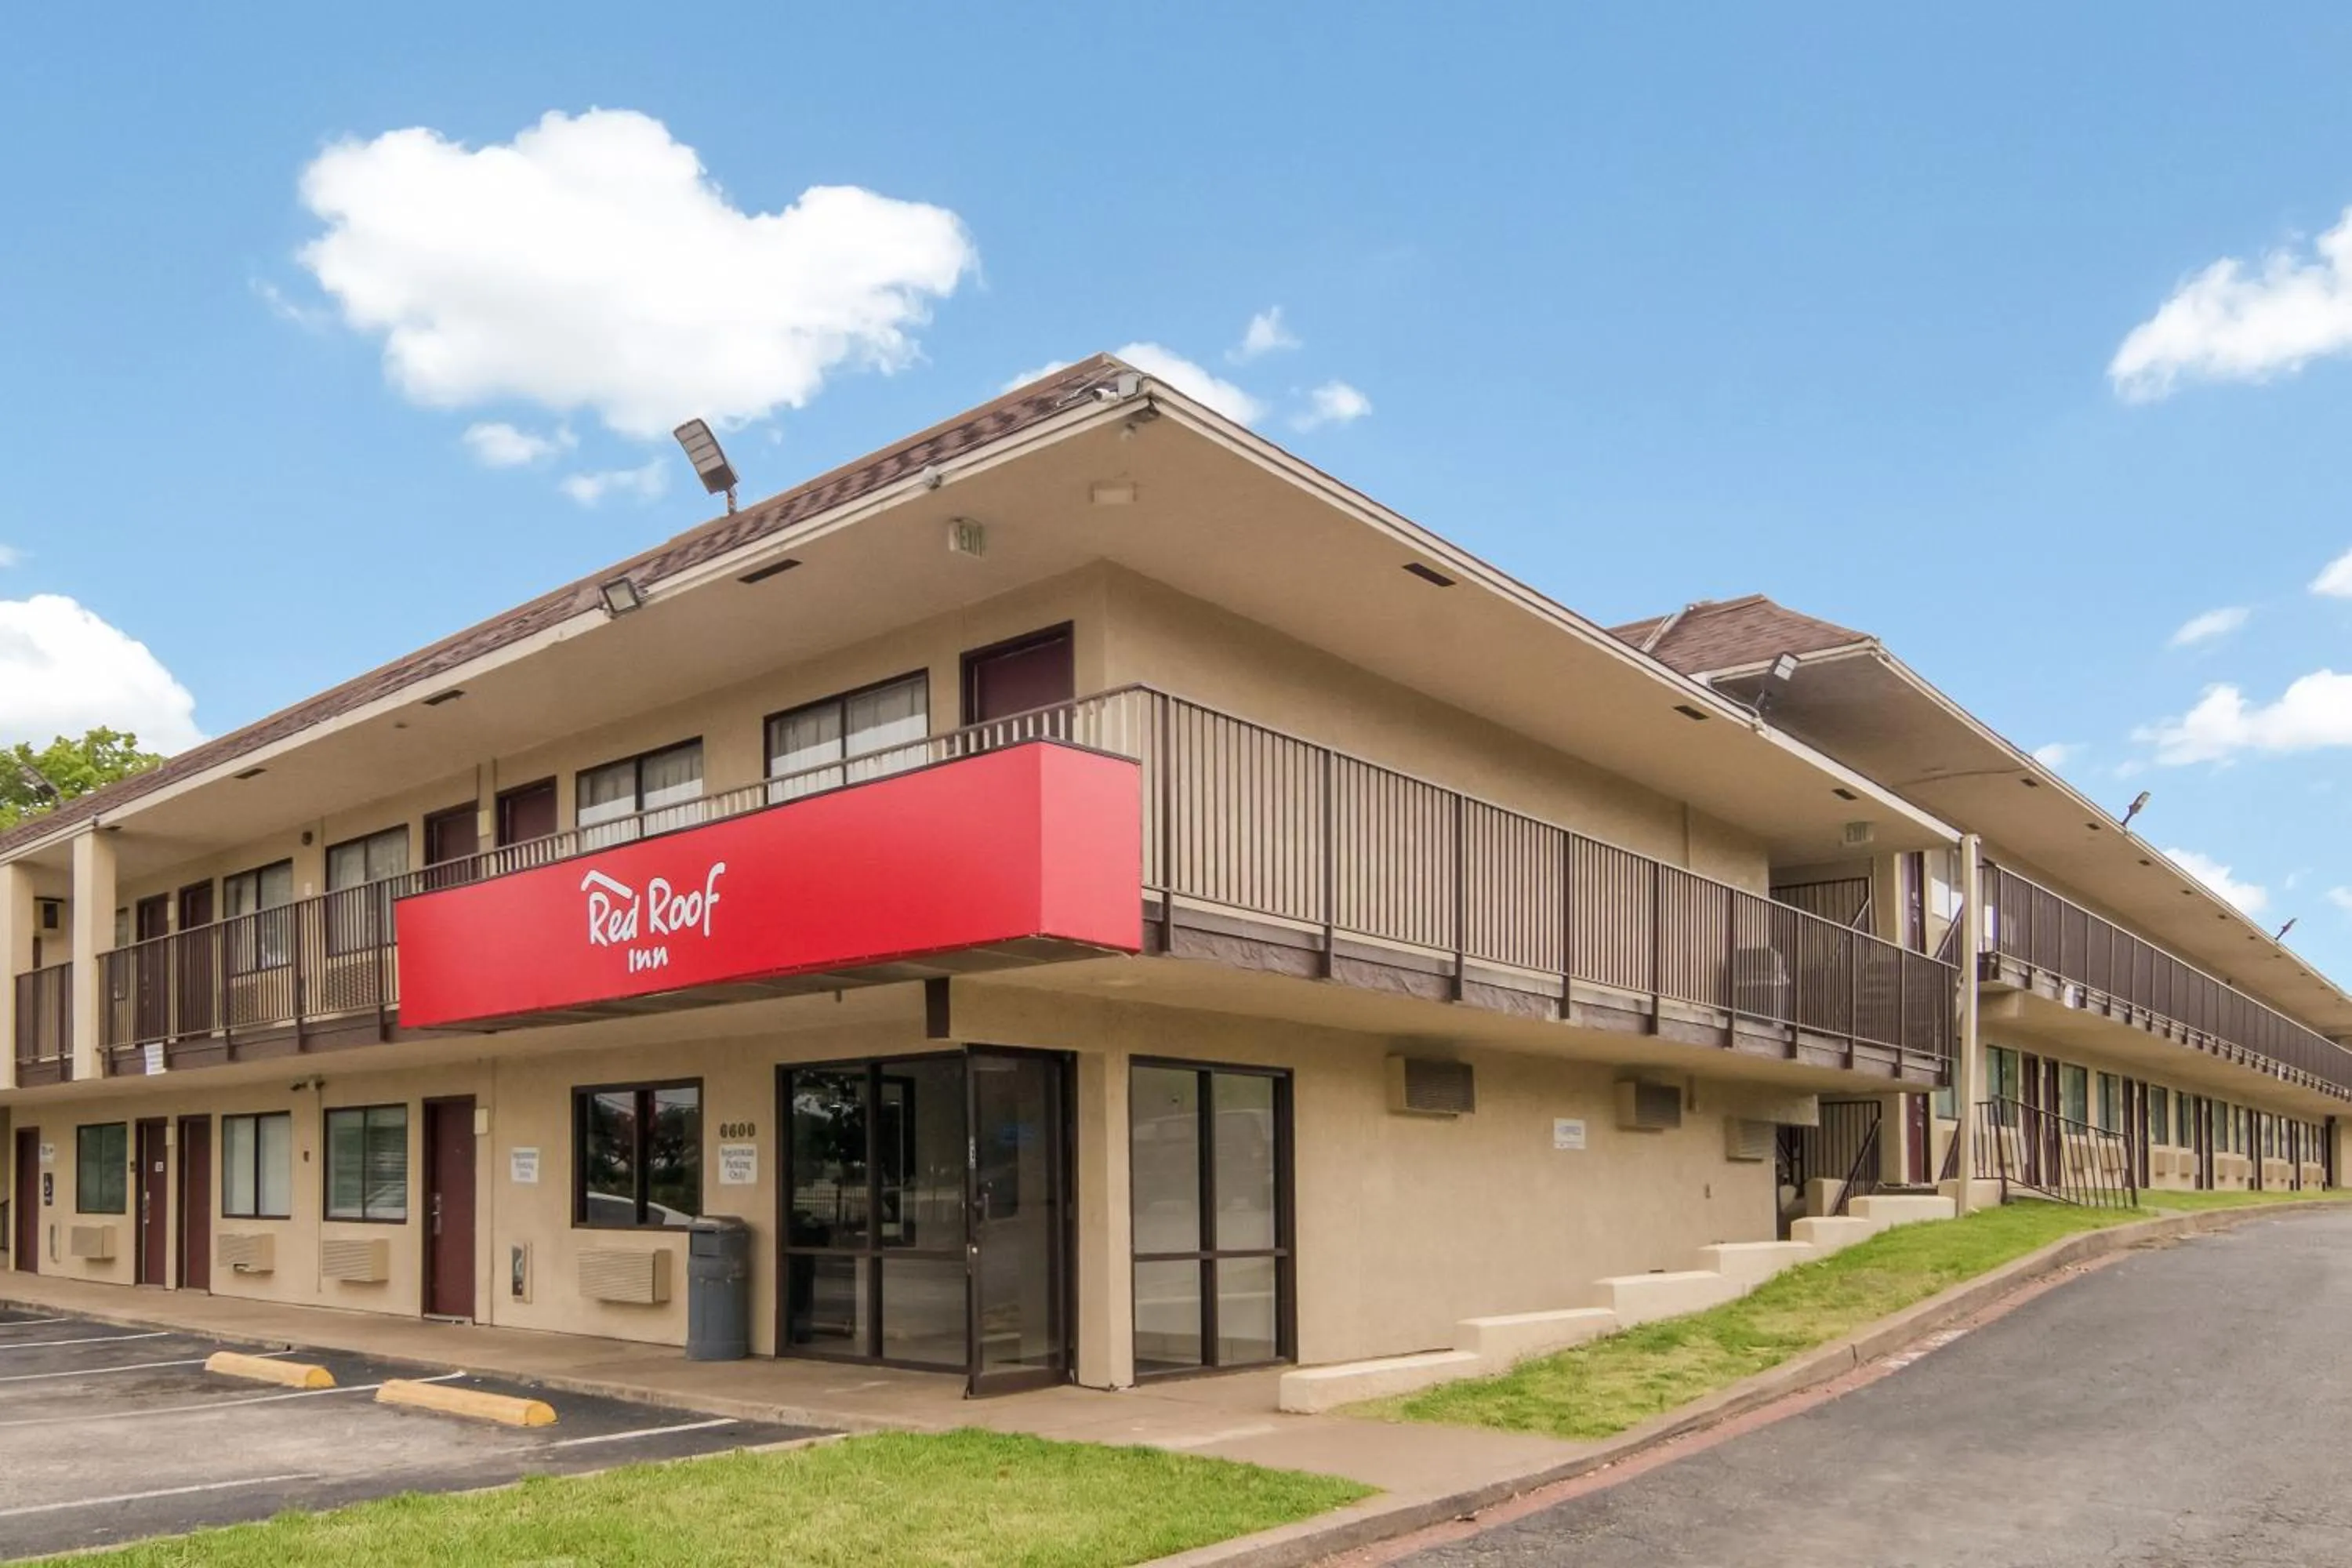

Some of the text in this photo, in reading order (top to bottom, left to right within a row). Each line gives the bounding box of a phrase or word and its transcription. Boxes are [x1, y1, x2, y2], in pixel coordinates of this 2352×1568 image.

[589, 862, 726, 947] Red Roof
[720, 1123, 756, 1138] 6600
